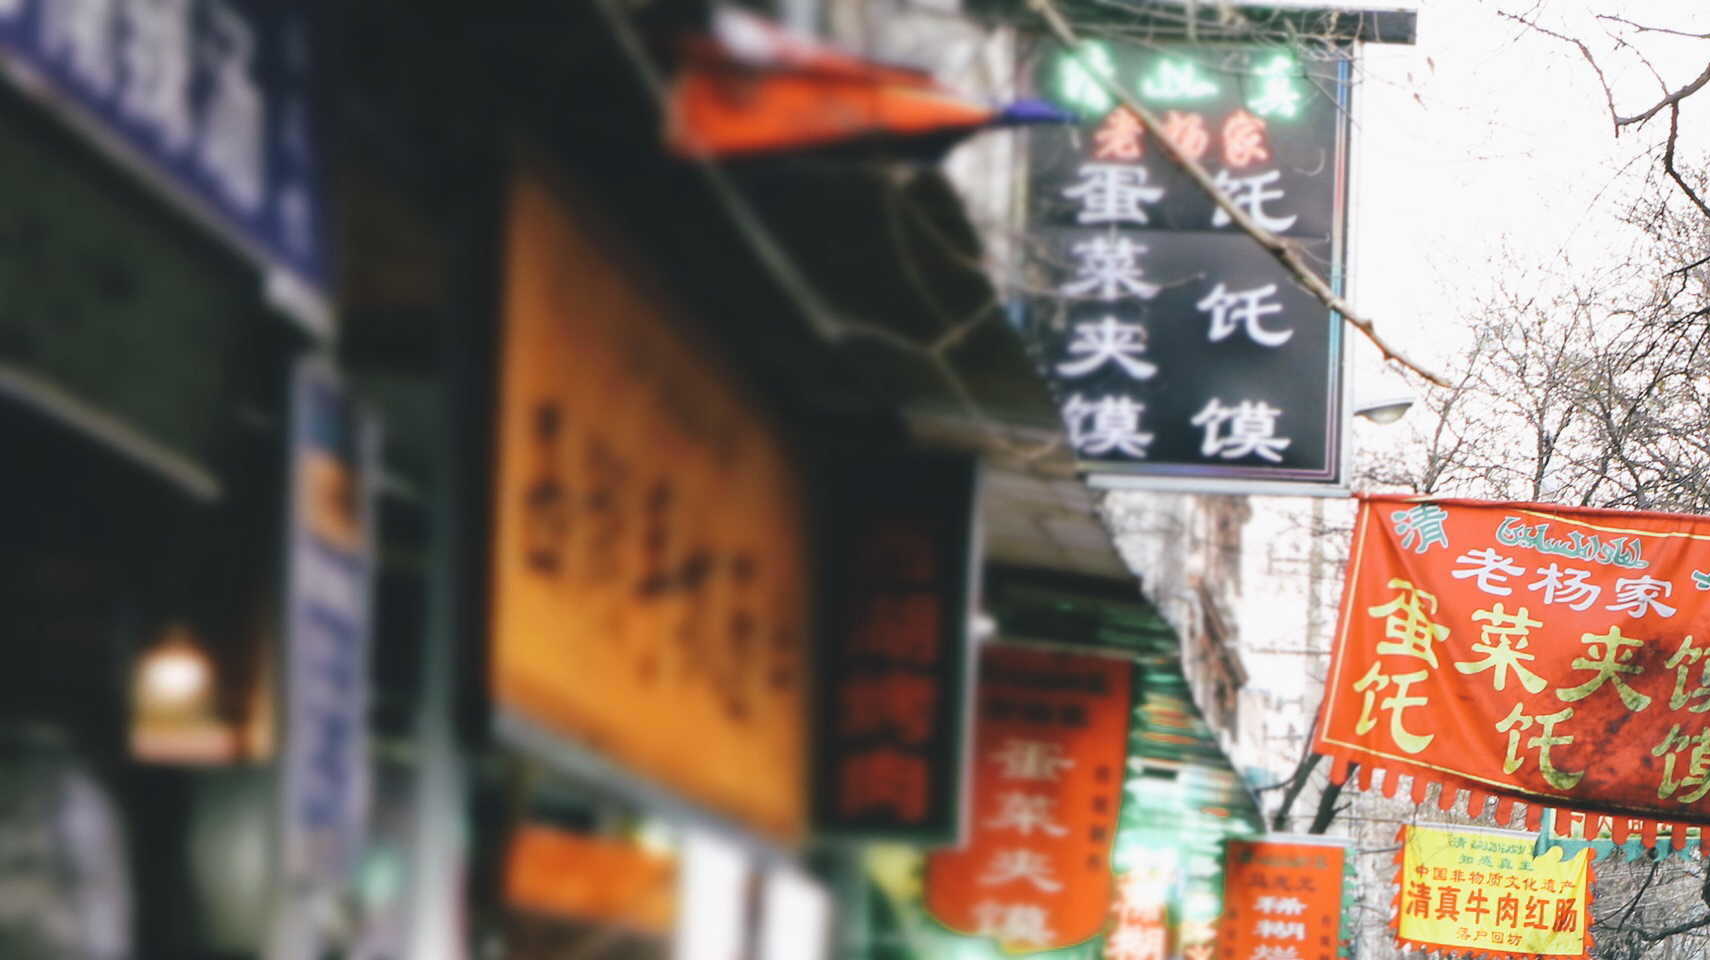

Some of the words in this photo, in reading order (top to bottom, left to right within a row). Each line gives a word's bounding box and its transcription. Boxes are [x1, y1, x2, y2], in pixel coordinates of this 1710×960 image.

[1057, 163, 1164, 459] 蛋菜夹馍
[1390, 502, 1451, 555] 清
[1450, 547, 1678, 619] 老杨家
[1405, 879, 1579, 934] 清真牛肉红肠
[1414, 864, 1577, 895] 中国非物质文化遗产
[1456, 926, 1524, 947] 落户回坊
